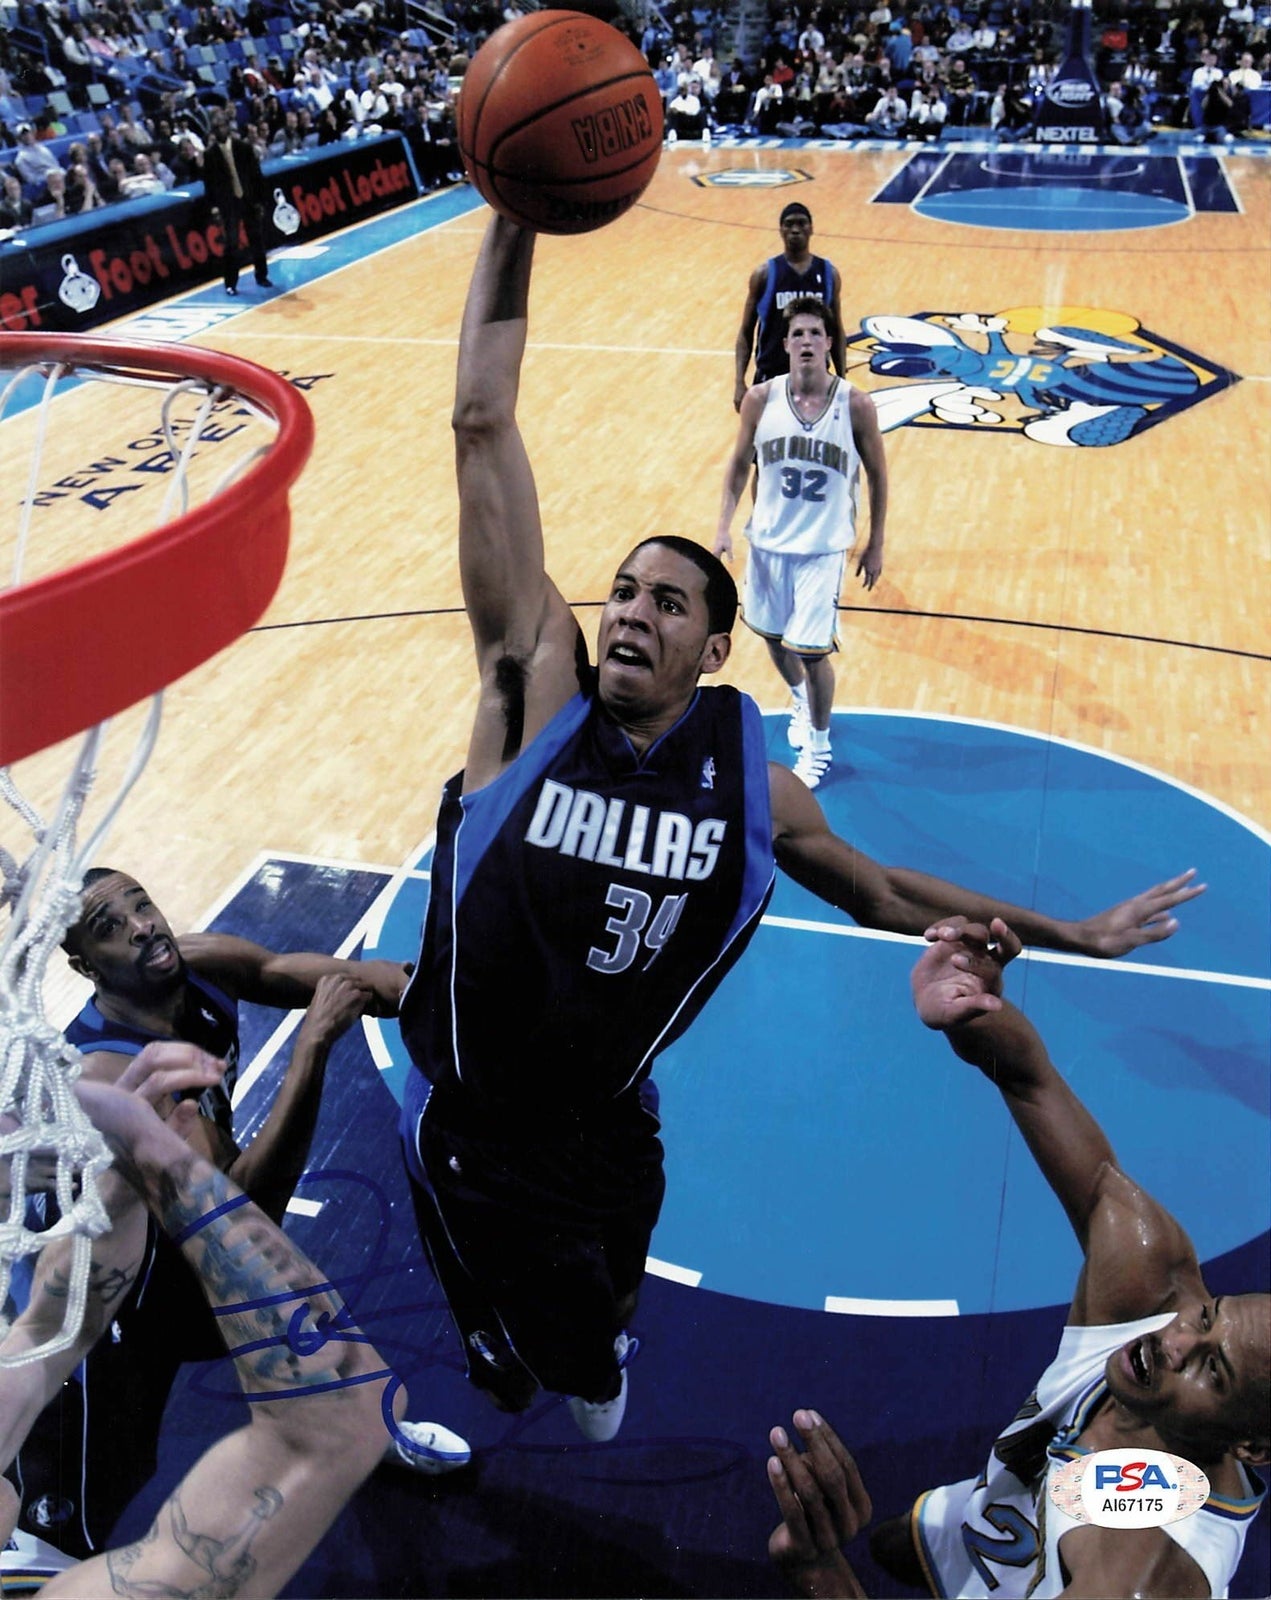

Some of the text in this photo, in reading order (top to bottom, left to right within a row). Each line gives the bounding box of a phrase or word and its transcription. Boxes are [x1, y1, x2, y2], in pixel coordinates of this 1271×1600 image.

[1036, 126, 1099, 141] NEXTEL
[292, 158, 410, 227] Foot Locker
[89, 224, 249, 299] Foot Loc
[80, 373, 335, 511] AREA
[20, 457, 128, 507] NEW
[781, 466, 828, 502] 32
[524, 778, 728, 881] DALLAS
[586, 883, 689, 974] 34
